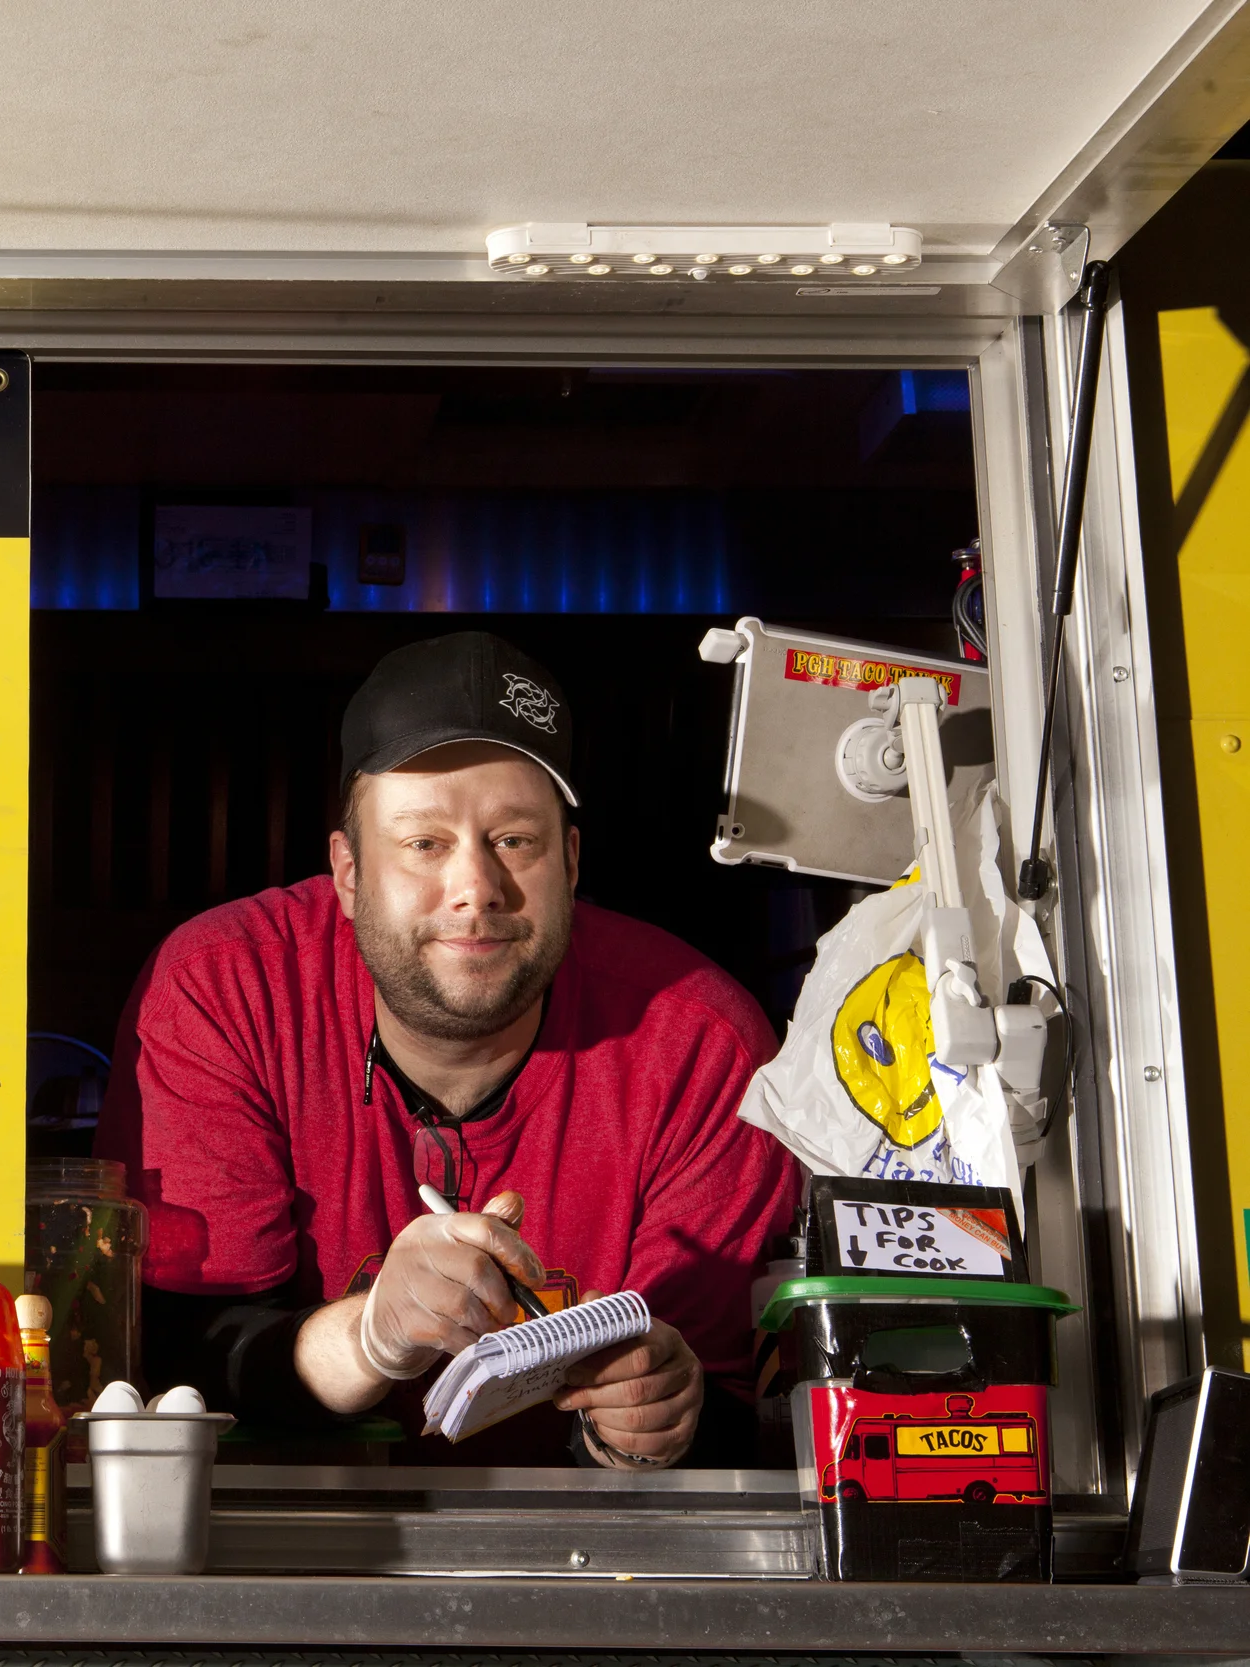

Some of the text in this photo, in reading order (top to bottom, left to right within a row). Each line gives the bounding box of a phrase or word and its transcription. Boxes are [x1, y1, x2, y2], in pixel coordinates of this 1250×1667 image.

[792, 650, 834, 679] PGH
[838, 658, 886, 685] TACO
[842, 1202, 935, 1232] TIPS
[875, 1231, 941, 1253] FOR
[948, 1212, 1007, 1252] MONEY CAN BUY
[893, 1253, 967, 1272] COOK
[919, 1429, 988, 1453] TACOS
